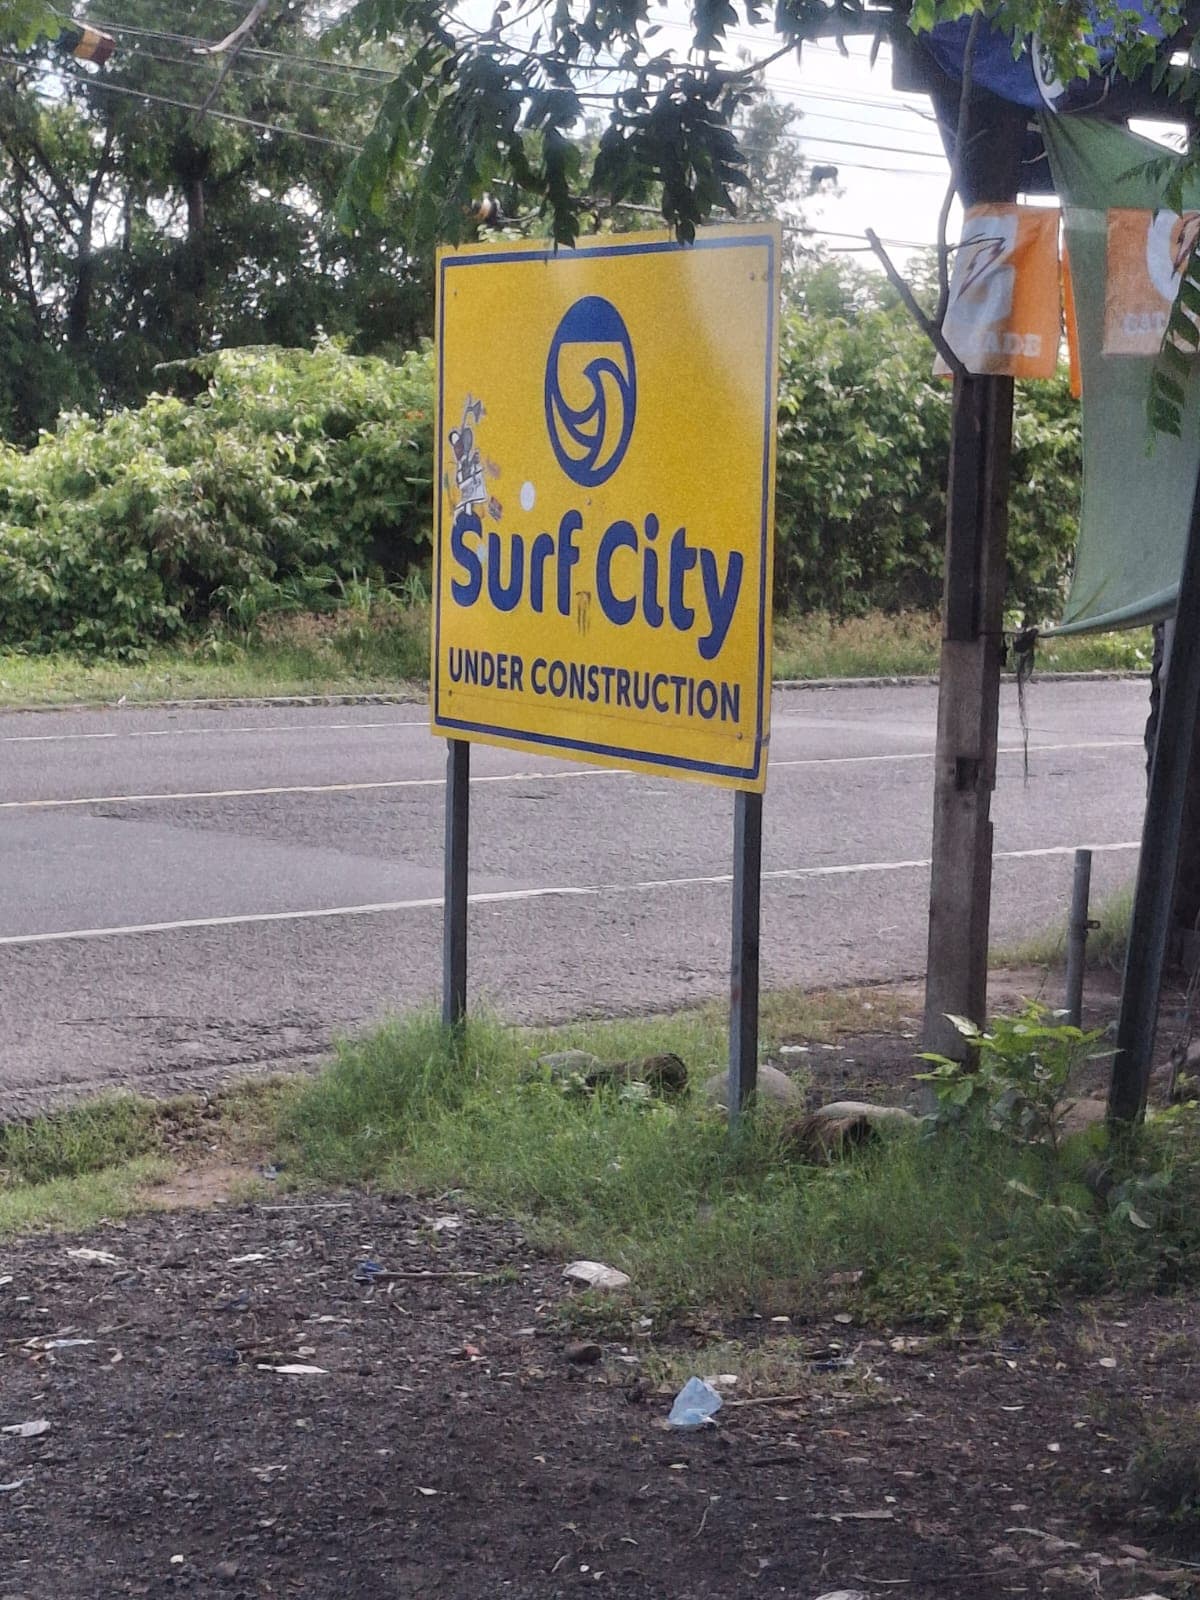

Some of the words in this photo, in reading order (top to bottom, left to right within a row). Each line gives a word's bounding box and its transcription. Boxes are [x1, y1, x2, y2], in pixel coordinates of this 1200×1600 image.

[450, 509, 583, 616] Surf
[596, 512, 744, 660] City
[449, 647, 524, 692] UNDER
[531, 658, 740, 723] CONSTRUCTION
